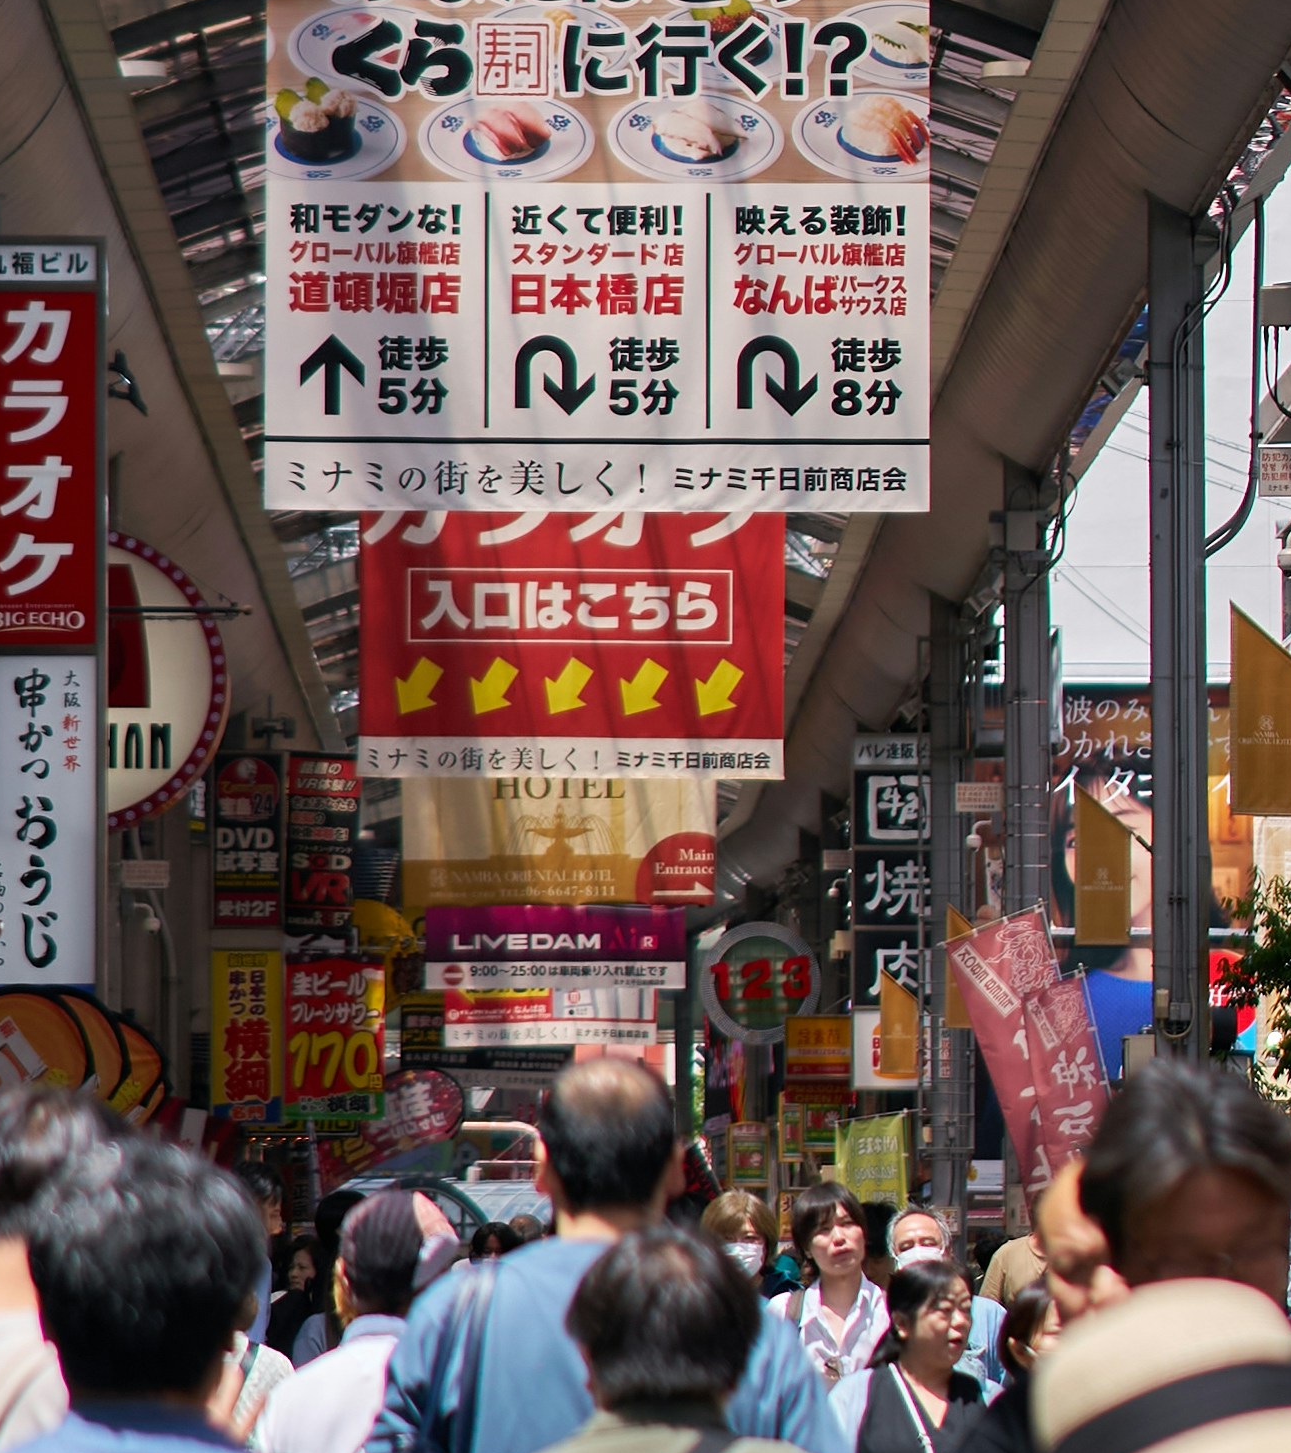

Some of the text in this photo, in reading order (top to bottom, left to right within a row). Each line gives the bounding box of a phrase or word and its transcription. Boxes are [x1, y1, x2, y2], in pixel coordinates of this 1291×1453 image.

[289, 203, 462, 236] 和モダンな!
[511, 203, 683, 236] 近くて便利!
[734, 204, 906, 236] 映える装飾!
[288, 241, 462, 267] グローバル旗艦店
[511, 243, 685, 268] スタンダード店
[733, 242, 907, 268] グローバル旗艦店
[288, 271, 462, 317] 道頓堀店
[511, 272, 685, 317] 日本橋店
[733, 273, 840, 317] なんば
[839, 274, 907, 296] パークス
[839, 296, 907, 317] サウス店
[378, 335, 449, 371] 徒歩
[608, 335, 680, 371] 徒歩
[831, 336, 903, 372] 徒歩
[378, 381, 449, 416] 5分
[608, 381, 680, 416] 5分
[831, 381, 903, 416] 8分
[285, 458, 907, 496] ミナミの街を美しく！ ミナミ千日前商店会
[28, 609, 86, 630] ECHO
[420, 580, 719, 632] 入口はこちら
[365, 746, 601, 772] ミナミの街を美しく！
[615, 752, 772, 770] ミナミ千日前商店会
[494, 778, 626, 800] HOTEL
[215, 827, 275, 849] DVD
[215, 850, 280, 872] 試写室
[292, 854, 353, 870] SOD
[655, 862, 715, 876] Entrance
[678, 848, 715, 862] Main
[291, 871, 351, 902] VR
[572, 868, 615, 882] HOTEL
[218, 900, 277, 917] 受付2F
[451, 933, 602, 951] LIVEDAM
[228, 969, 247, 1016] 串かつ
[249, 969, 266, 1016] 日本一の
[291, 971, 367, 996] 生ビール
[710, 955, 812, 1001] 123
[291, 1002, 380, 1025] プレーンサワー
[223, 1017, 272, 1103] 横綱
